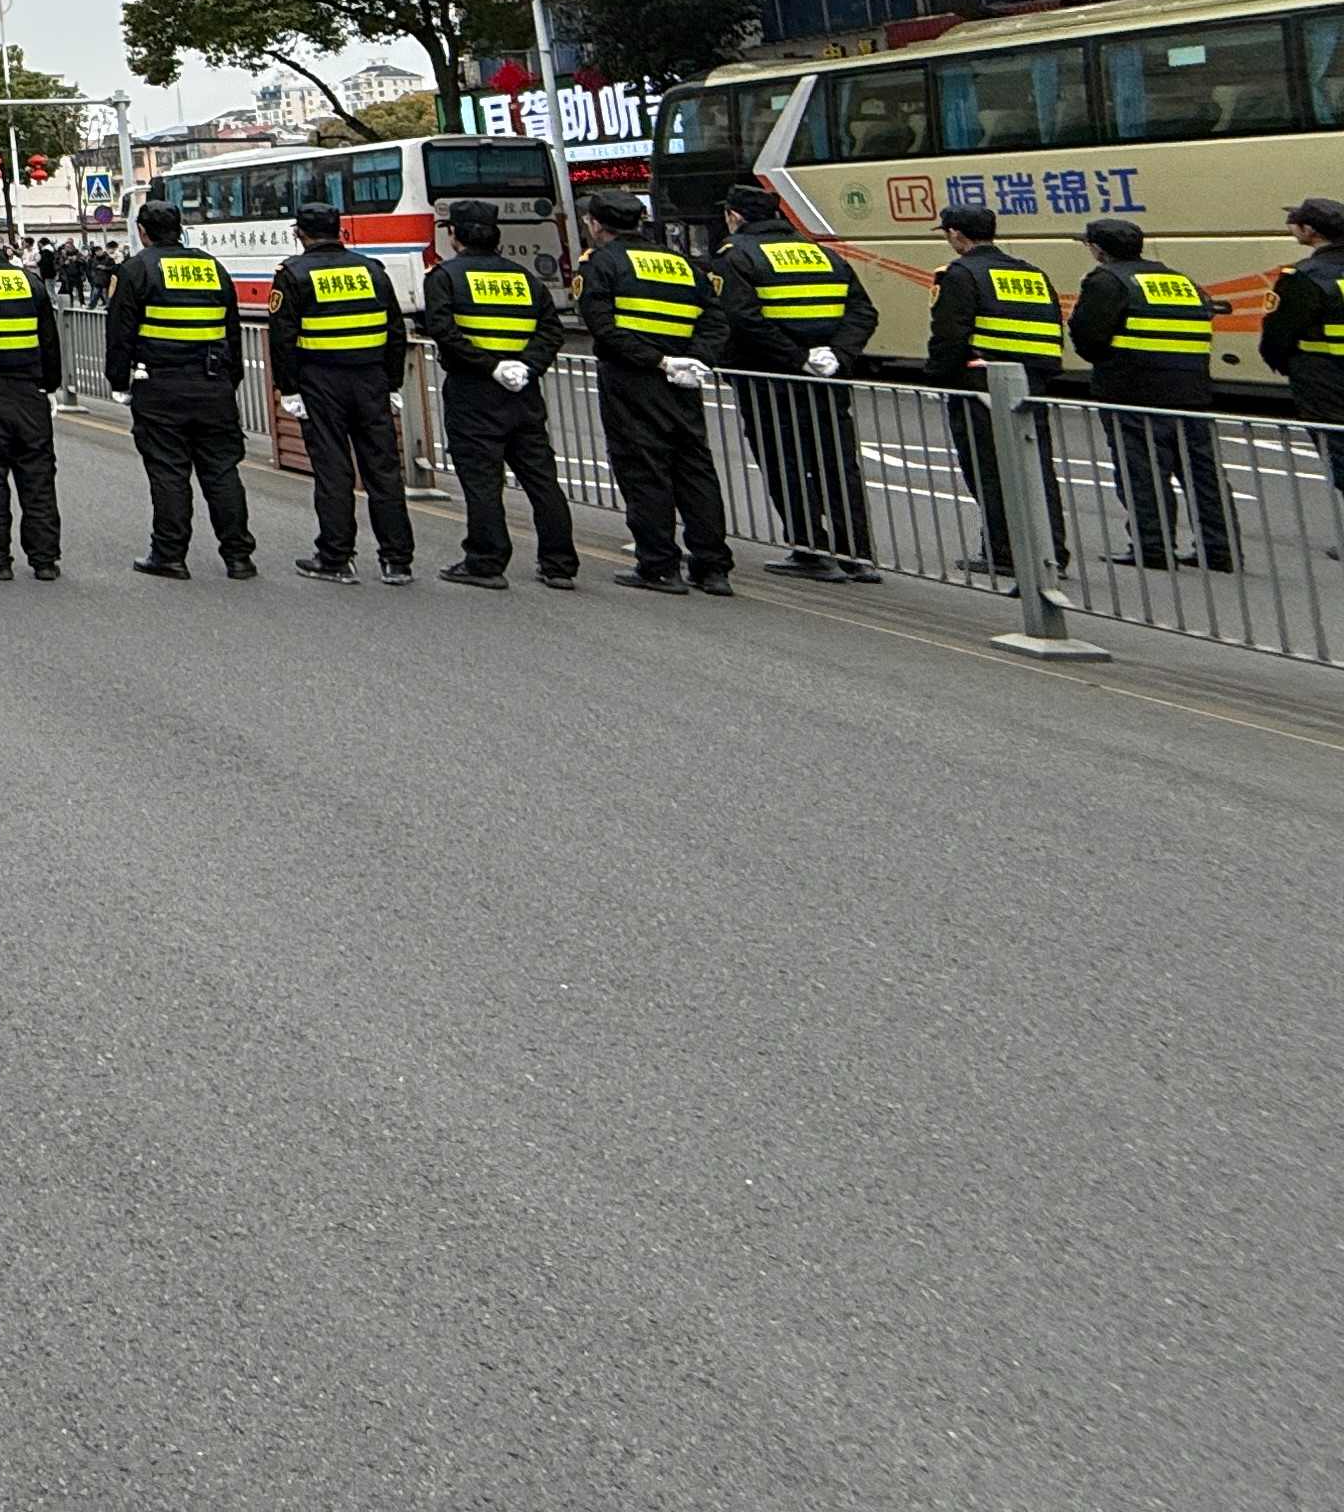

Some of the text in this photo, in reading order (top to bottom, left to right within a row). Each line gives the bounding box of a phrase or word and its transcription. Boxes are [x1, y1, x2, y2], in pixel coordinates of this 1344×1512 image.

[895, 185, 931, 214] HR
[945, 168, 1146, 216] 恒瑞锦江
[773, 250, 826, 266] 利邦保安
[168, 266, 216, 283] 利邦保安
[638, 259, 689, 277] 利邦保安
[318, 274, 369, 294] 利邦保安
[474, 279, 526, 298] 利邦保安
[997, 277, 1046, 297] 利邦保安
[1145, 282, 1194, 298] 利邦保安
